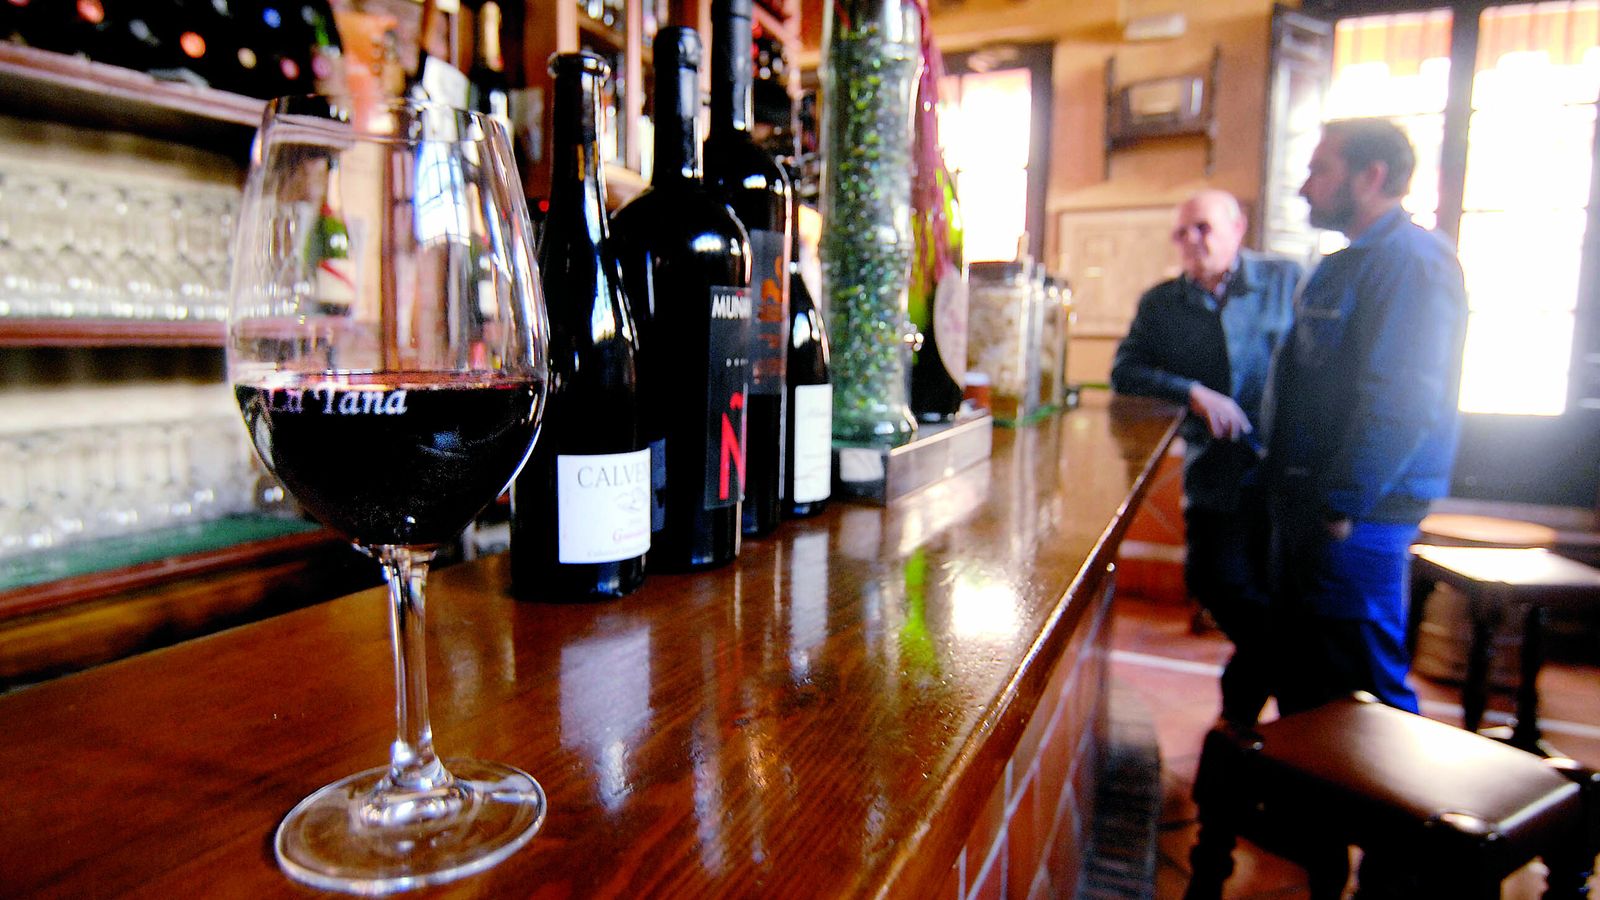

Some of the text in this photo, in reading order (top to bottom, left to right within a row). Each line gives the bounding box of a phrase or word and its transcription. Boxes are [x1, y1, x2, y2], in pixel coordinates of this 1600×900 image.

[265, 382, 408, 415] La Tana
[577, 462, 648, 488] CALVE
